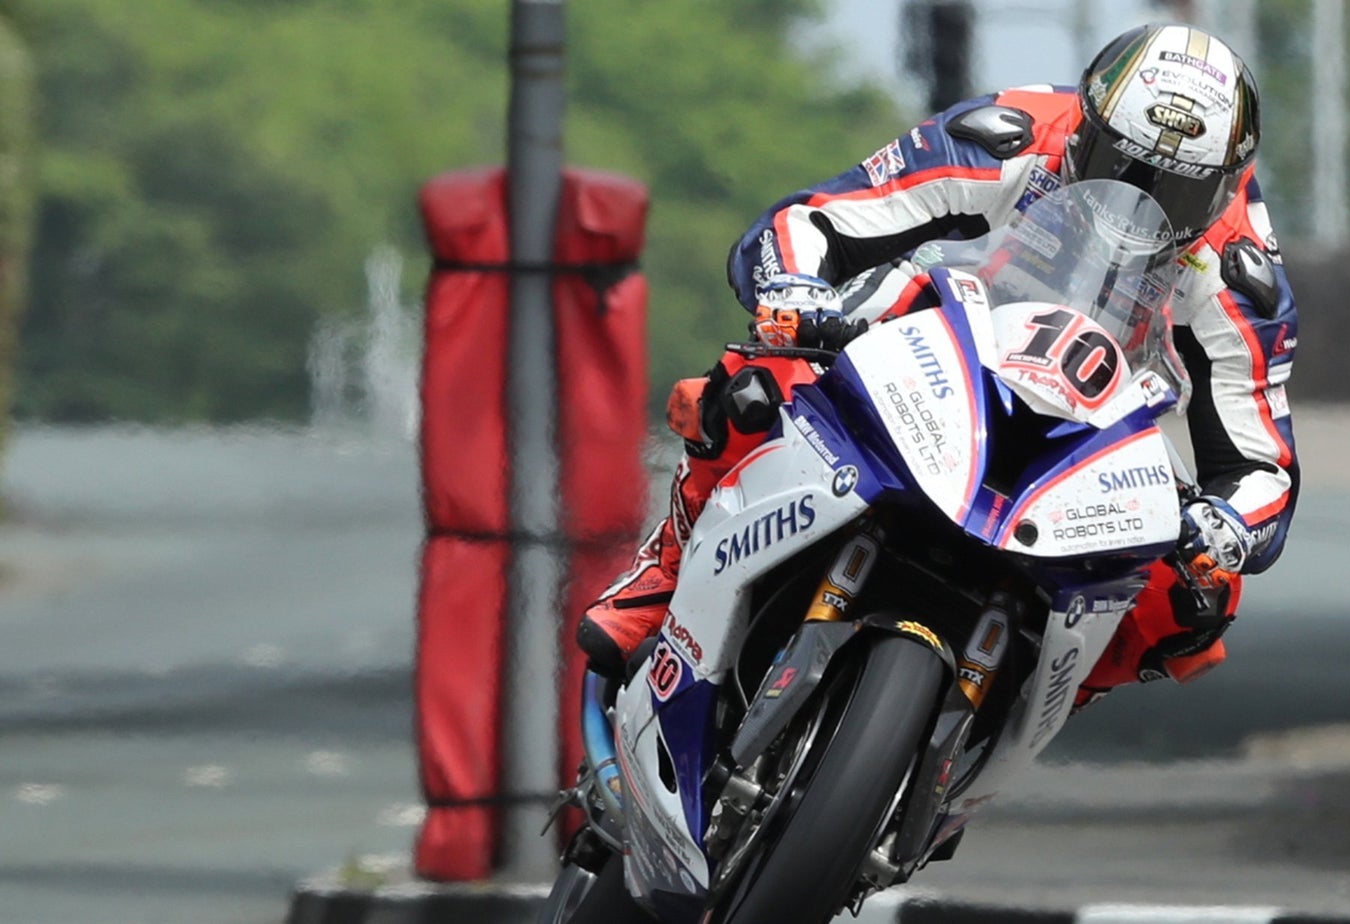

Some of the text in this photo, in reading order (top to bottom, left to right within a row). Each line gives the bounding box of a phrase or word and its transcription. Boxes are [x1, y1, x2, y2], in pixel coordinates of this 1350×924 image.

[1164, 52, 1224, 84] BATHGATE
[1162, 70, 1234, 108] EVOLUTION
[899, 326, 954, 399] SMITHS
[1006, 309, 1118, 399] 10
[884, 382, 941, 476] ROBOTS LTD
[909, 391, 946, 454] GLOBAL
[1098, 465, 1170, 494] SMITHS
[1053, 518, 1144, 541] ROBOTS LTD
[1066, 503, 1126, 521] GLOBAL
[713, 494, 816, 576] SMITHS
[823, 592, 848, 612] TTX
[650, 647, 679, 692] 10
[960, 667, 985, 686] TTX
